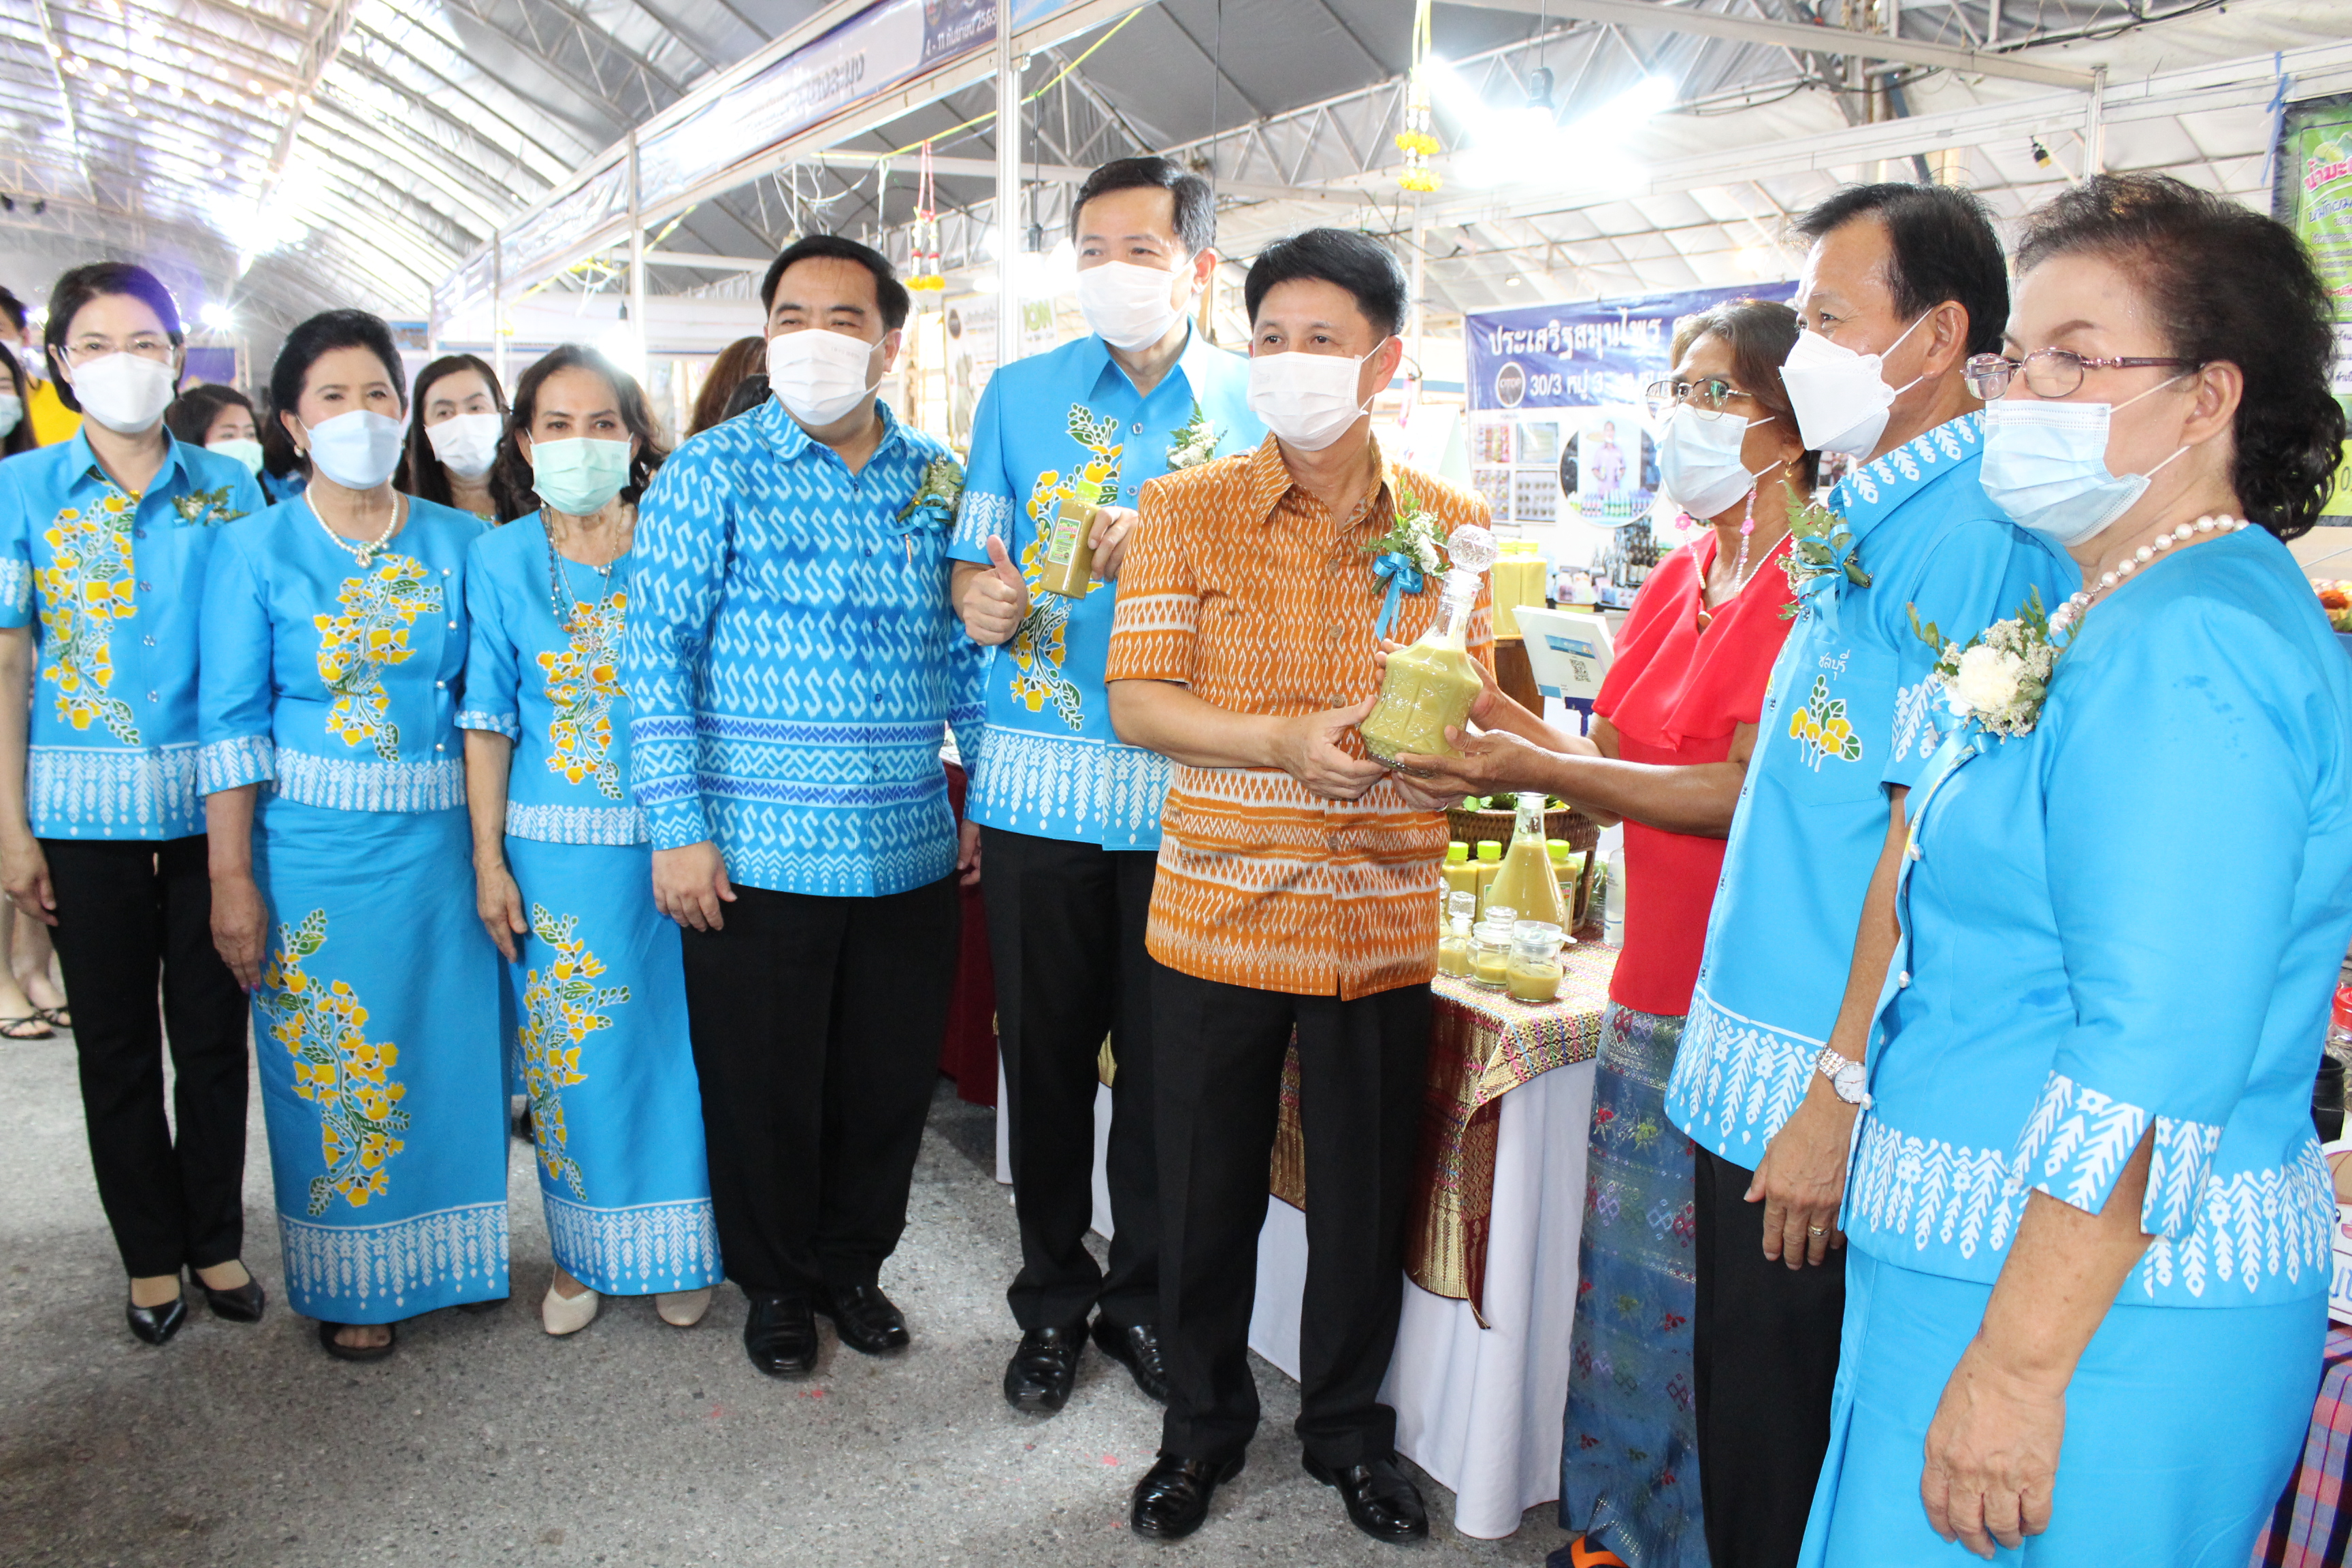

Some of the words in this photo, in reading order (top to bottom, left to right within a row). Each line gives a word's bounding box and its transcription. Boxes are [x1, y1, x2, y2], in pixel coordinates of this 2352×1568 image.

[976, 6, 996, 33] 2565
[1488, 306, 1663, 361] ประเสริฐสมุนไพร
[1529, 373, 1563, 397] 30/3
[1818, 649, 1851, 681] ชลบุรี
